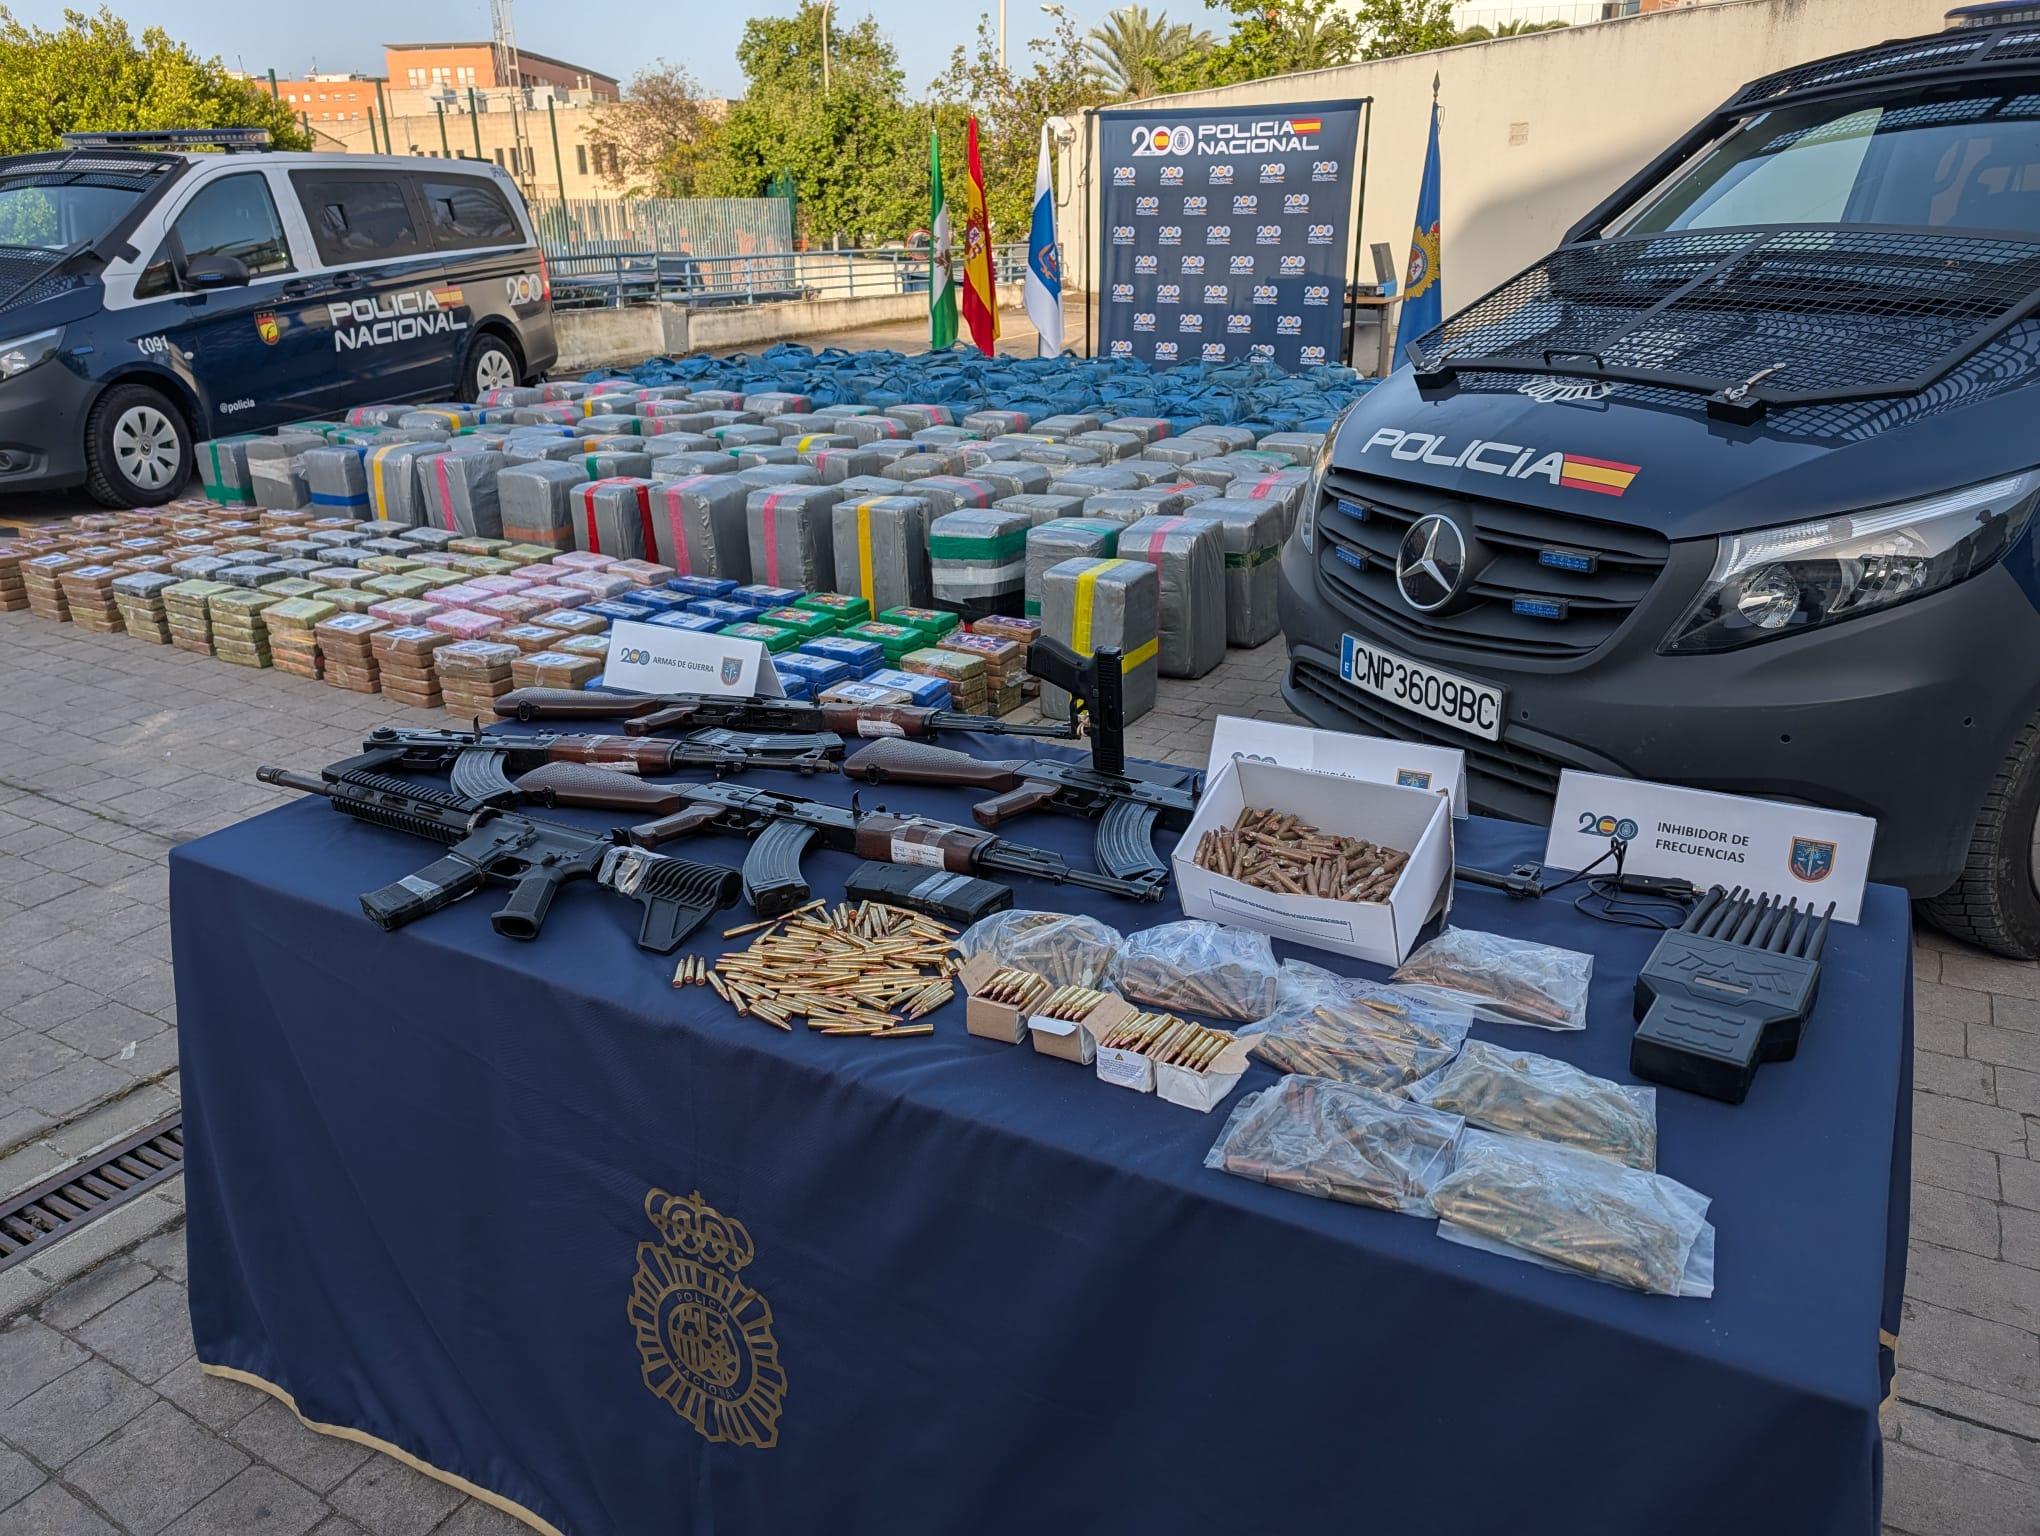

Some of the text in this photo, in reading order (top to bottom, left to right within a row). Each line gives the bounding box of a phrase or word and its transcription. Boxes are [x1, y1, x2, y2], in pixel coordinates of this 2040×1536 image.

[1131, 125, 1195, 157] 200
[1197, 136, 1320, 155] NACIONAL
[506, 274, 542, 305] 200
[334, 311, 467, 352] NACIONAL
[652, 656, 714, 672] ARMAS DE GUERRA
[1344, 662, 1350, 672] E
[1354, 648, 1496, 730] CNP3609BC
[1577, 811, 1639, 841] 200
[1657, 821, 1750, 847] INHIBIDOR DE
[1655, 838, 1746, 864] FRECUENCIAS
[676, 1291, 729, 1321] POLICIA
